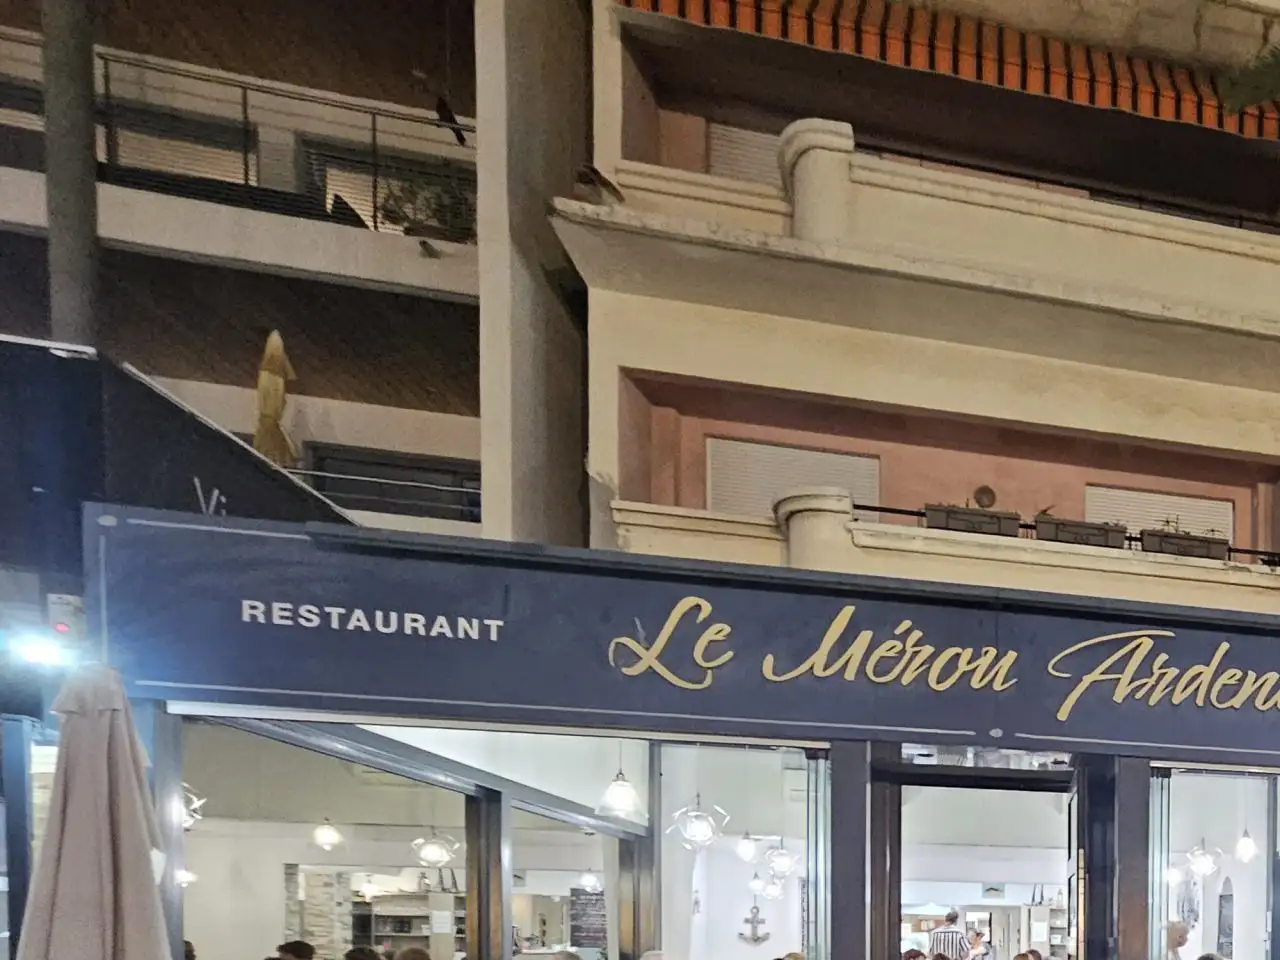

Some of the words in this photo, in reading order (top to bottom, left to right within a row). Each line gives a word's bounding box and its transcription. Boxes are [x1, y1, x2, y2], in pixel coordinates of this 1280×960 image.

[241, 600, 504, 641] RESTAURANT
[609, 596, 734, 689] Le
[762, 605, 1018, 691] Mérou
